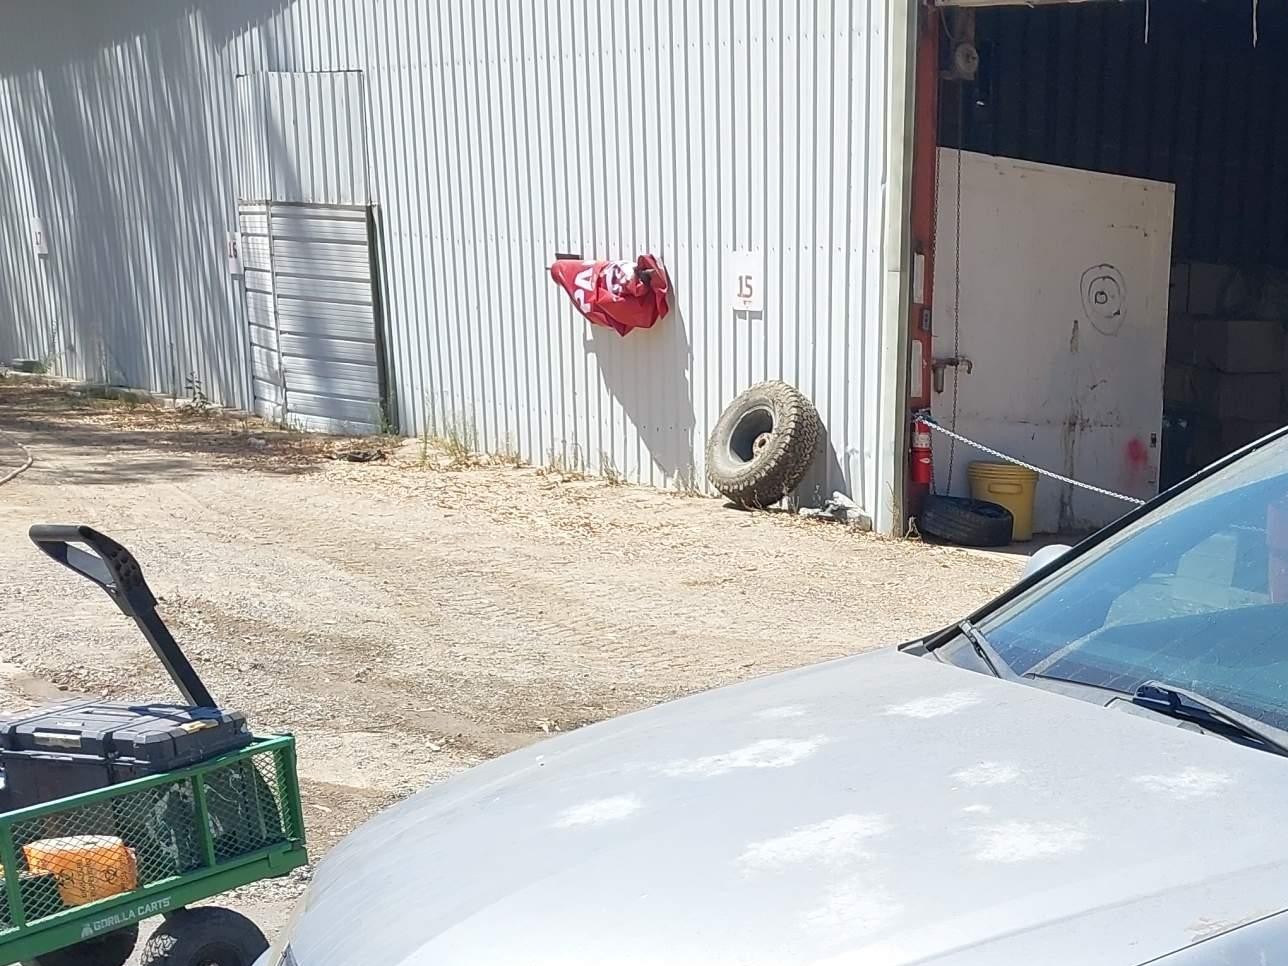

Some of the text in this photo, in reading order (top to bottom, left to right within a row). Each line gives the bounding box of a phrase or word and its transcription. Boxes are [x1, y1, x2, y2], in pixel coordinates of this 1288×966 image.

[736, 274, 753, 299] 15
[93, 896, 171, 931] GORILLA CARTS
